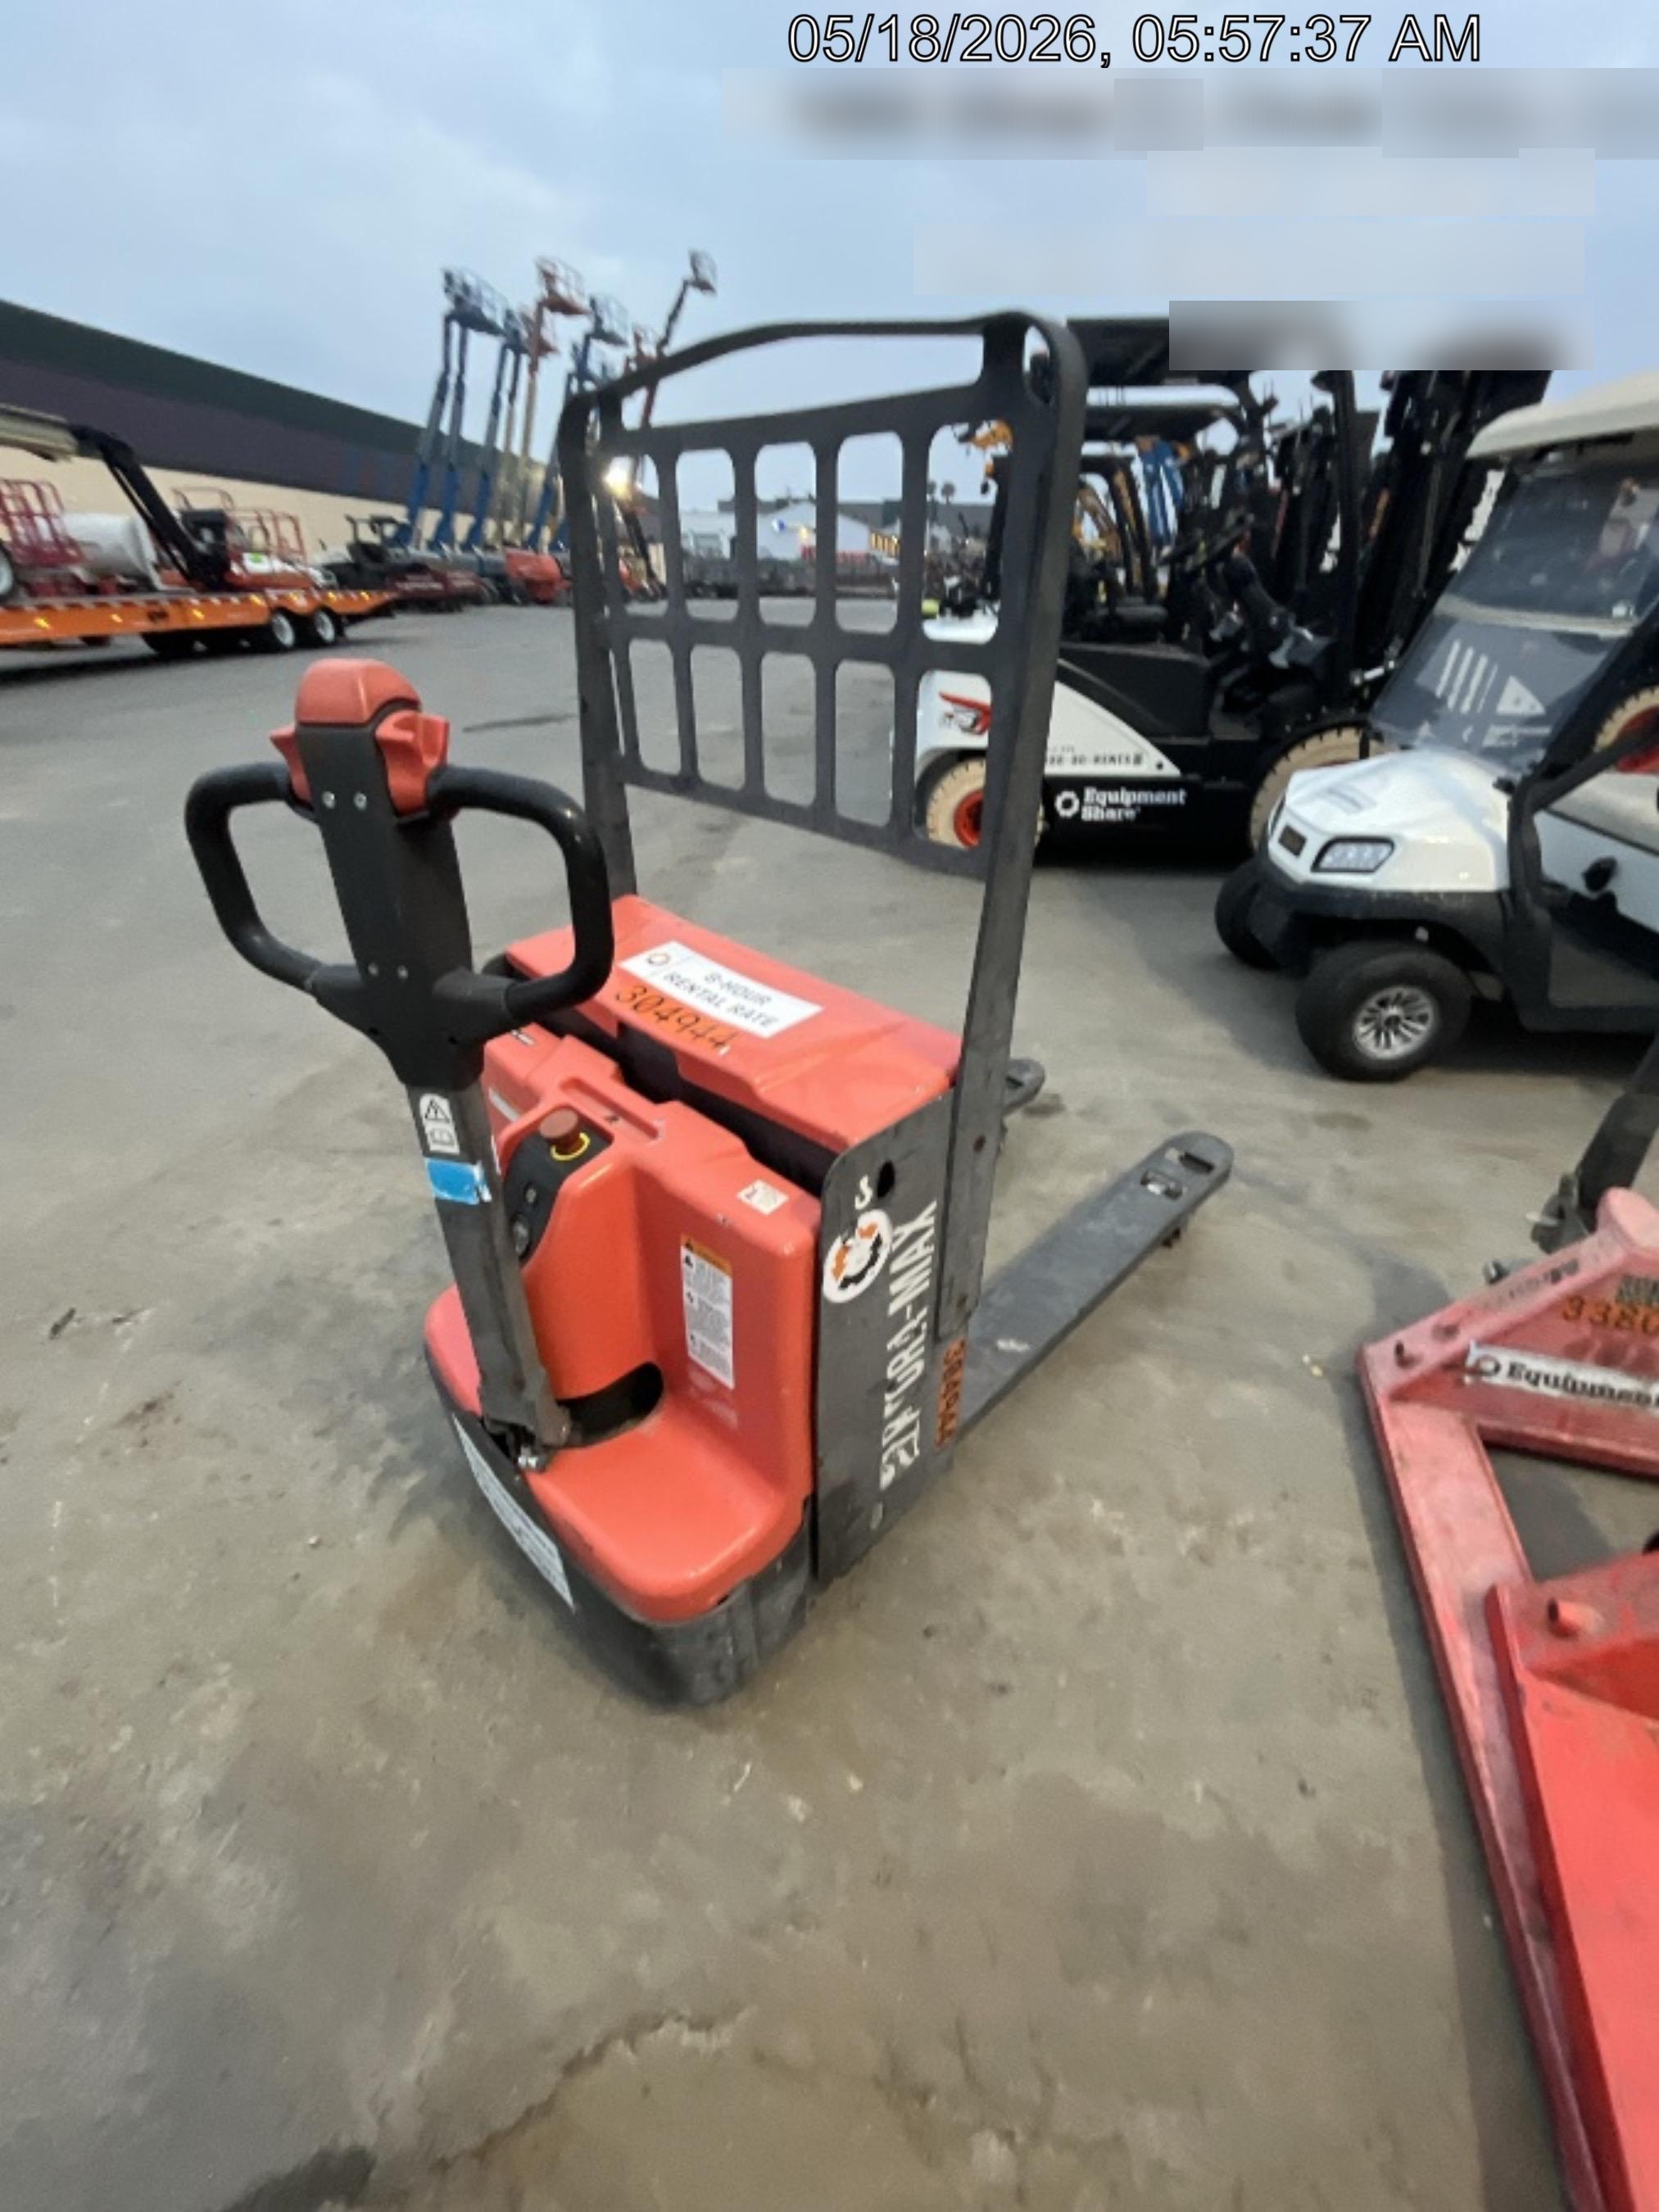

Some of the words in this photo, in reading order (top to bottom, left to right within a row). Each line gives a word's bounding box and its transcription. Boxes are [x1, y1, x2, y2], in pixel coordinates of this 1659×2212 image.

[1081, 805, 1137, 822] Share
[1083, 786, 1187, 807] Equipment
[616, 985, 737, 1049] 304944
[664, 971, 727, 1008] RENTAL
[728, 1004, 780, 1028] RATE
